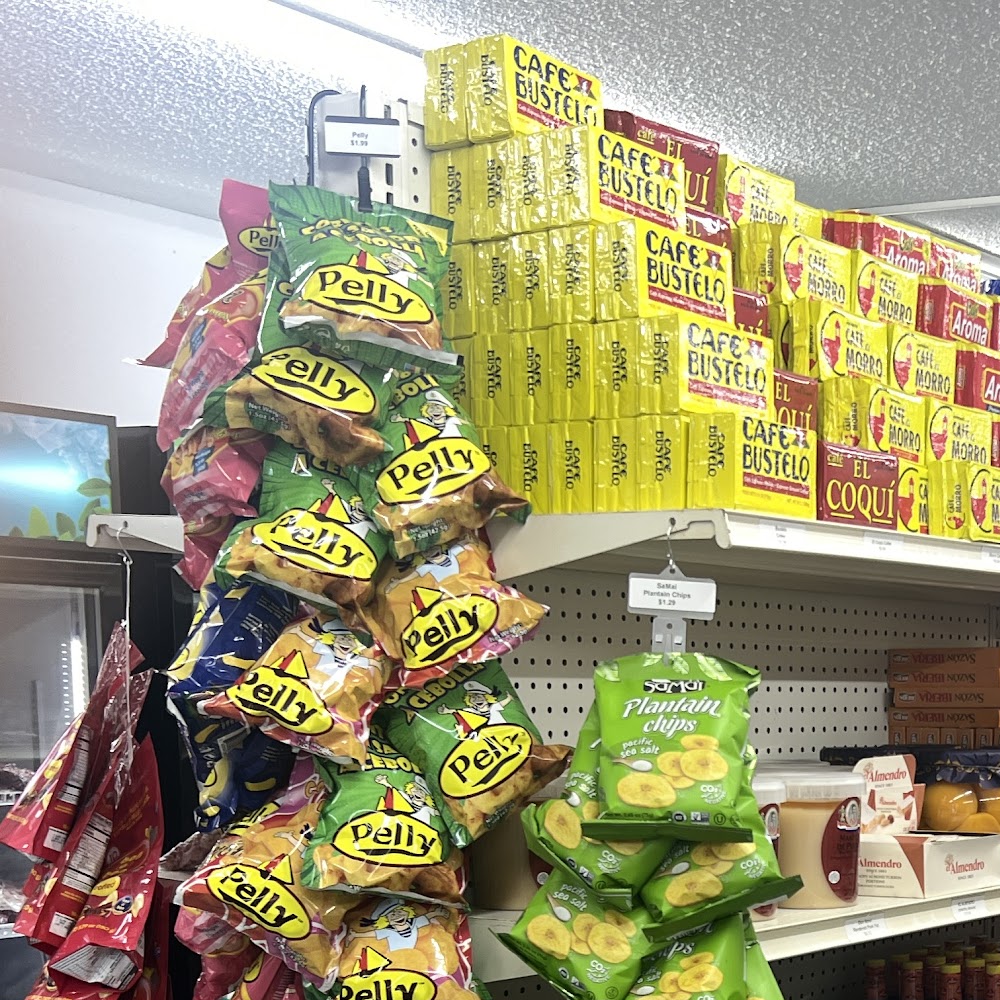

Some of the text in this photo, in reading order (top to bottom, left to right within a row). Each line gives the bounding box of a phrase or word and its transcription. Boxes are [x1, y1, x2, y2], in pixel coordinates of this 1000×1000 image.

[515, 72, 597, 126] BUSTELO
[351, 132, 368, 140] Pelly
[599, 161, 677, 214] BUSTELO
[318, 270, 414, 314] Pelly
[647, 257, 725, 304] BUSTELO
[878, 296, 912, 324] MORRO
[952, 318, 988, 346] Aroma
[688, 351, 766, 393] BUSTELO
[846, 348, 882, 377] MORRO
[776, 382, 791, 402] EL
[916, 370, 950, 393] MORRO
[889, 429, 921, 452] MORRO
[952, 444, 987, 464] MORRO
[386, 445, 476, 490] Pelly
[743, 444, 809, 482] BUSTELO
[854, 460, 871, 479] EL
[826, 480, 895, 524] COQUÍ
[270, 514, 364, 566] Pelly
[643, 590, 691, 600] Plantain Chips
[405, 600, 479, 659] Pelly
[245, 670, 318, 725] Pelly
[622, 695, 722, 719] Plantain
[642, 714, 698, 738] chips
[620, 744, 660, 758] sea salt
[622, 737, 654, 750] pacific
[448, 732, 522, 784] Pelly
[351, 822, 437, 857] Pelly
[220, 866, 299, 928] Pelly
[552, 890, 588, 911] sea salt
[561, 883, 587, 900] pacific
